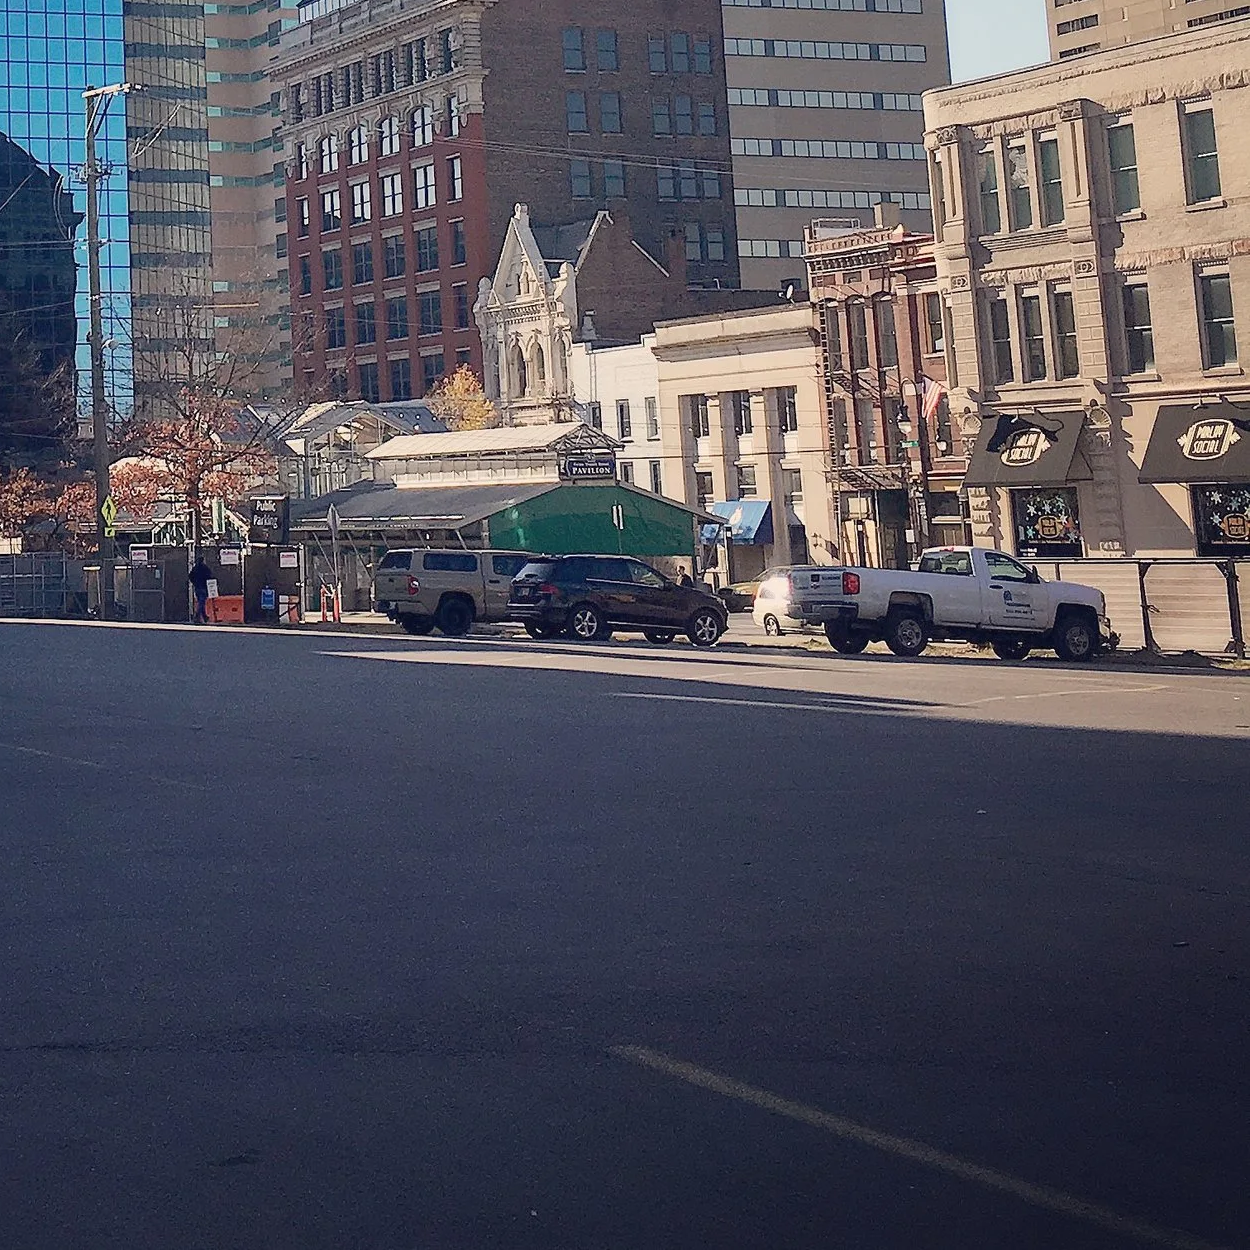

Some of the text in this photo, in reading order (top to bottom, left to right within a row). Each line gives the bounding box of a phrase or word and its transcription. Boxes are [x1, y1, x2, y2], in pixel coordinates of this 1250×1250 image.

[1191, 439, 1220, 454] SOCIAL
[572, 466, 611, 475] PAVILION
[256, 500, 276, 512] Public
[253, 514, 278, 529] Parking
